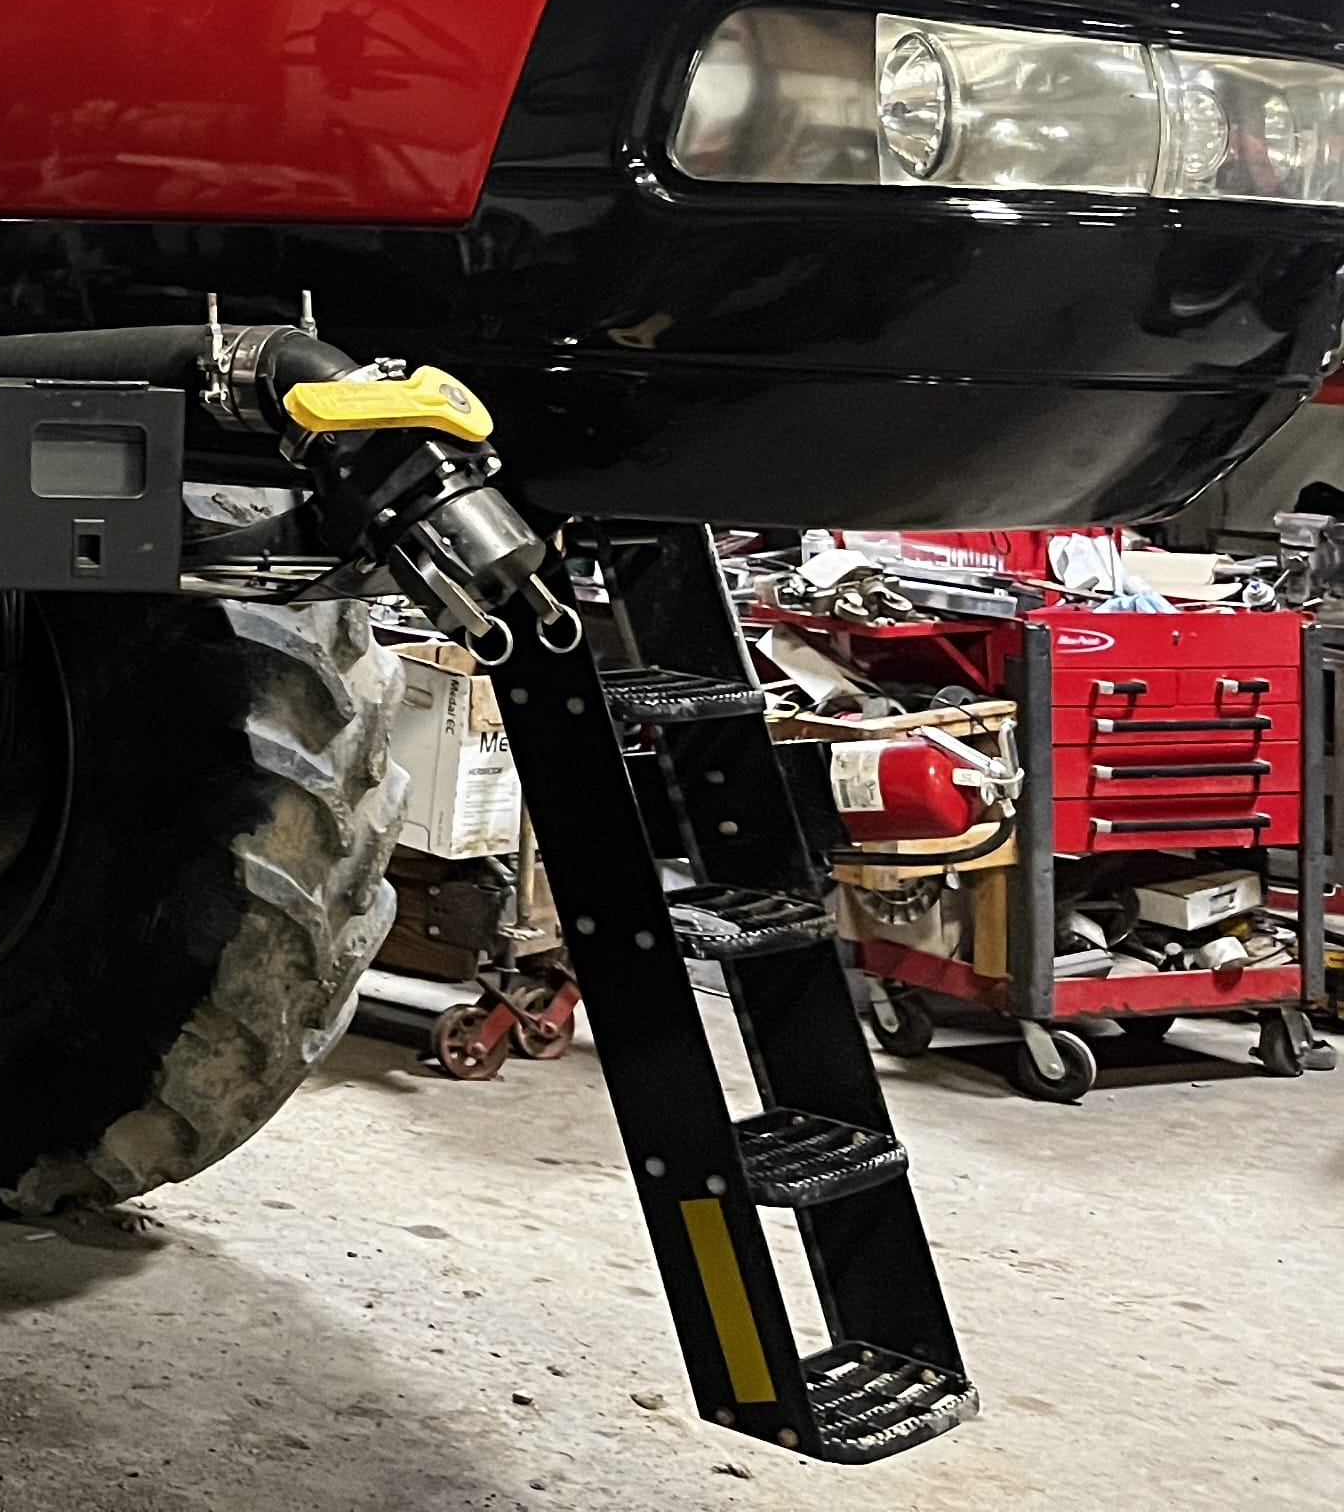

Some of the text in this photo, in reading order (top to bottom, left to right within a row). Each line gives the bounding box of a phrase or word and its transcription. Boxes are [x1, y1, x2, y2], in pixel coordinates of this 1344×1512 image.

[445, 678, 460, 736] Medal EC
[479, 731, 509, 753] Me
